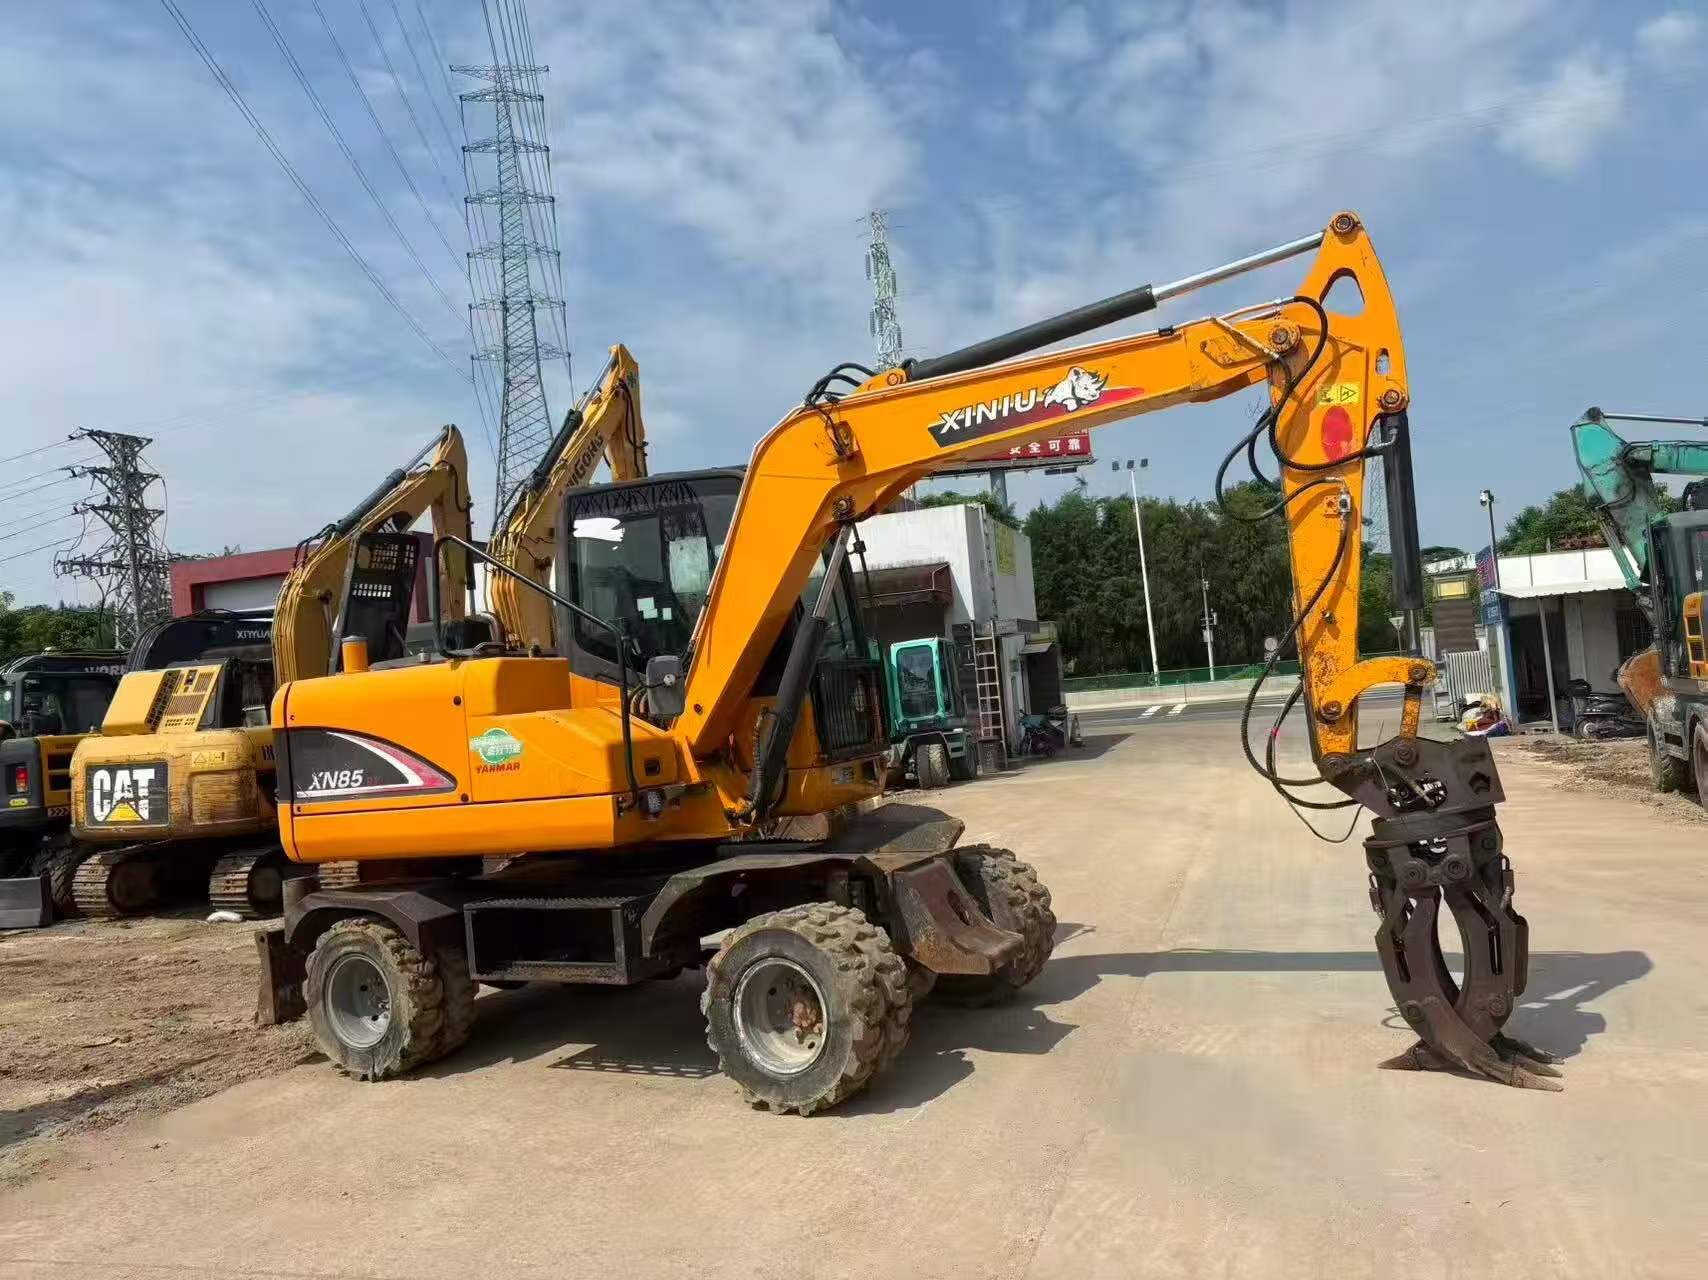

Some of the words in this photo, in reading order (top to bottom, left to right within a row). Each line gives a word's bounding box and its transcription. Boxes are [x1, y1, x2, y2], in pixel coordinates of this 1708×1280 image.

[940, 388, 1037, 434] XINIU
[92, 768, 156, 822] CAT
[308, 769, 364, 790] XN85
